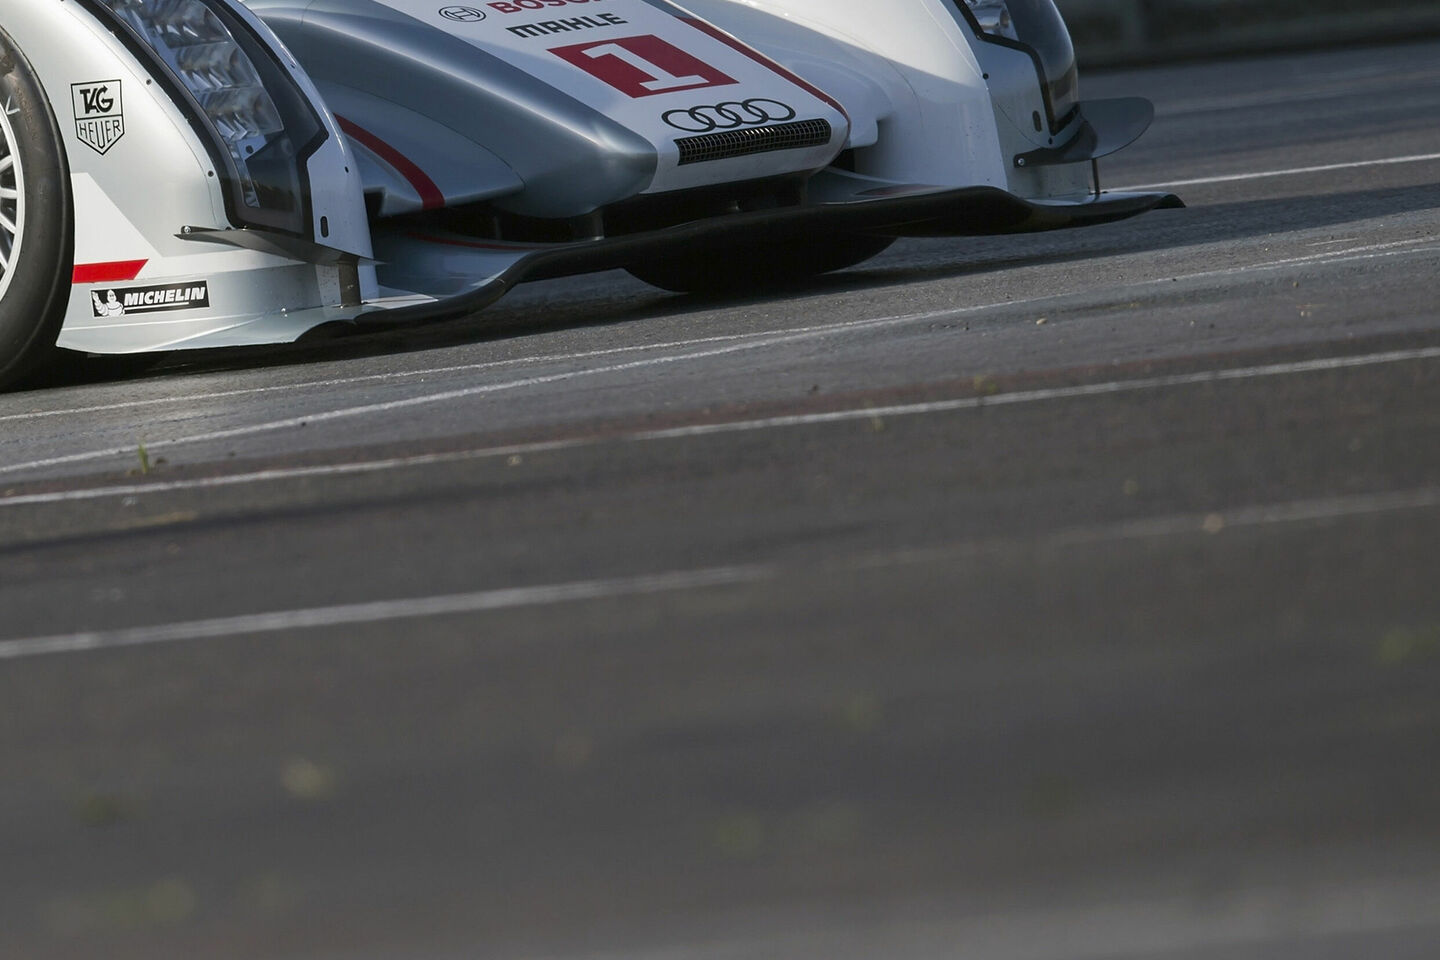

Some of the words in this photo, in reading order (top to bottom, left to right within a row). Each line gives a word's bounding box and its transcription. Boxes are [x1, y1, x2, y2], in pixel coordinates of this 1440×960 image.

[506, 12, 629, 39] MAHLE
[581, 42, 711, 92] 1
[79, 84, 114, 114] TAG
[79, 119, 122, 150] HEUER
[123, 286, 206, 307] MICHELIN
